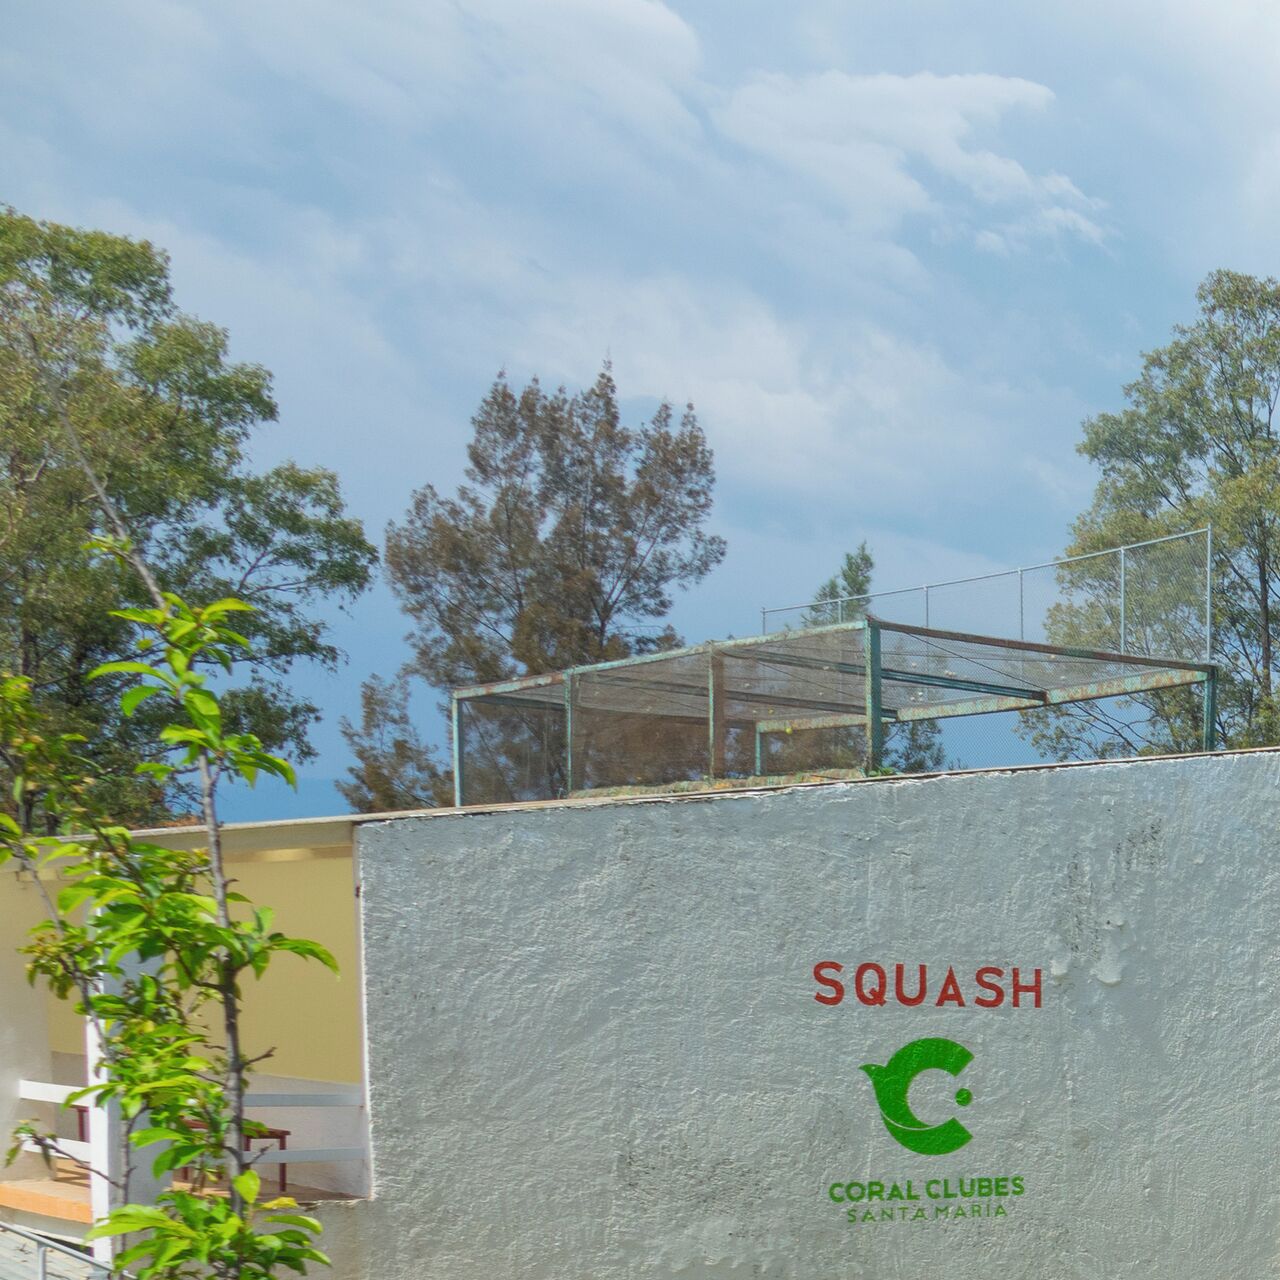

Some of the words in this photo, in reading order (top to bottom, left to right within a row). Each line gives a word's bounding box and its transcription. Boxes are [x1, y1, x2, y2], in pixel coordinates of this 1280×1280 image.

[813, 960, 1042, 1008] SQUASH
[828, 1180, 920, 1203] CORAL
[925, 1175, 1025, 1199] CLUBES
[847, 1206, 928, 1223] SANTA
